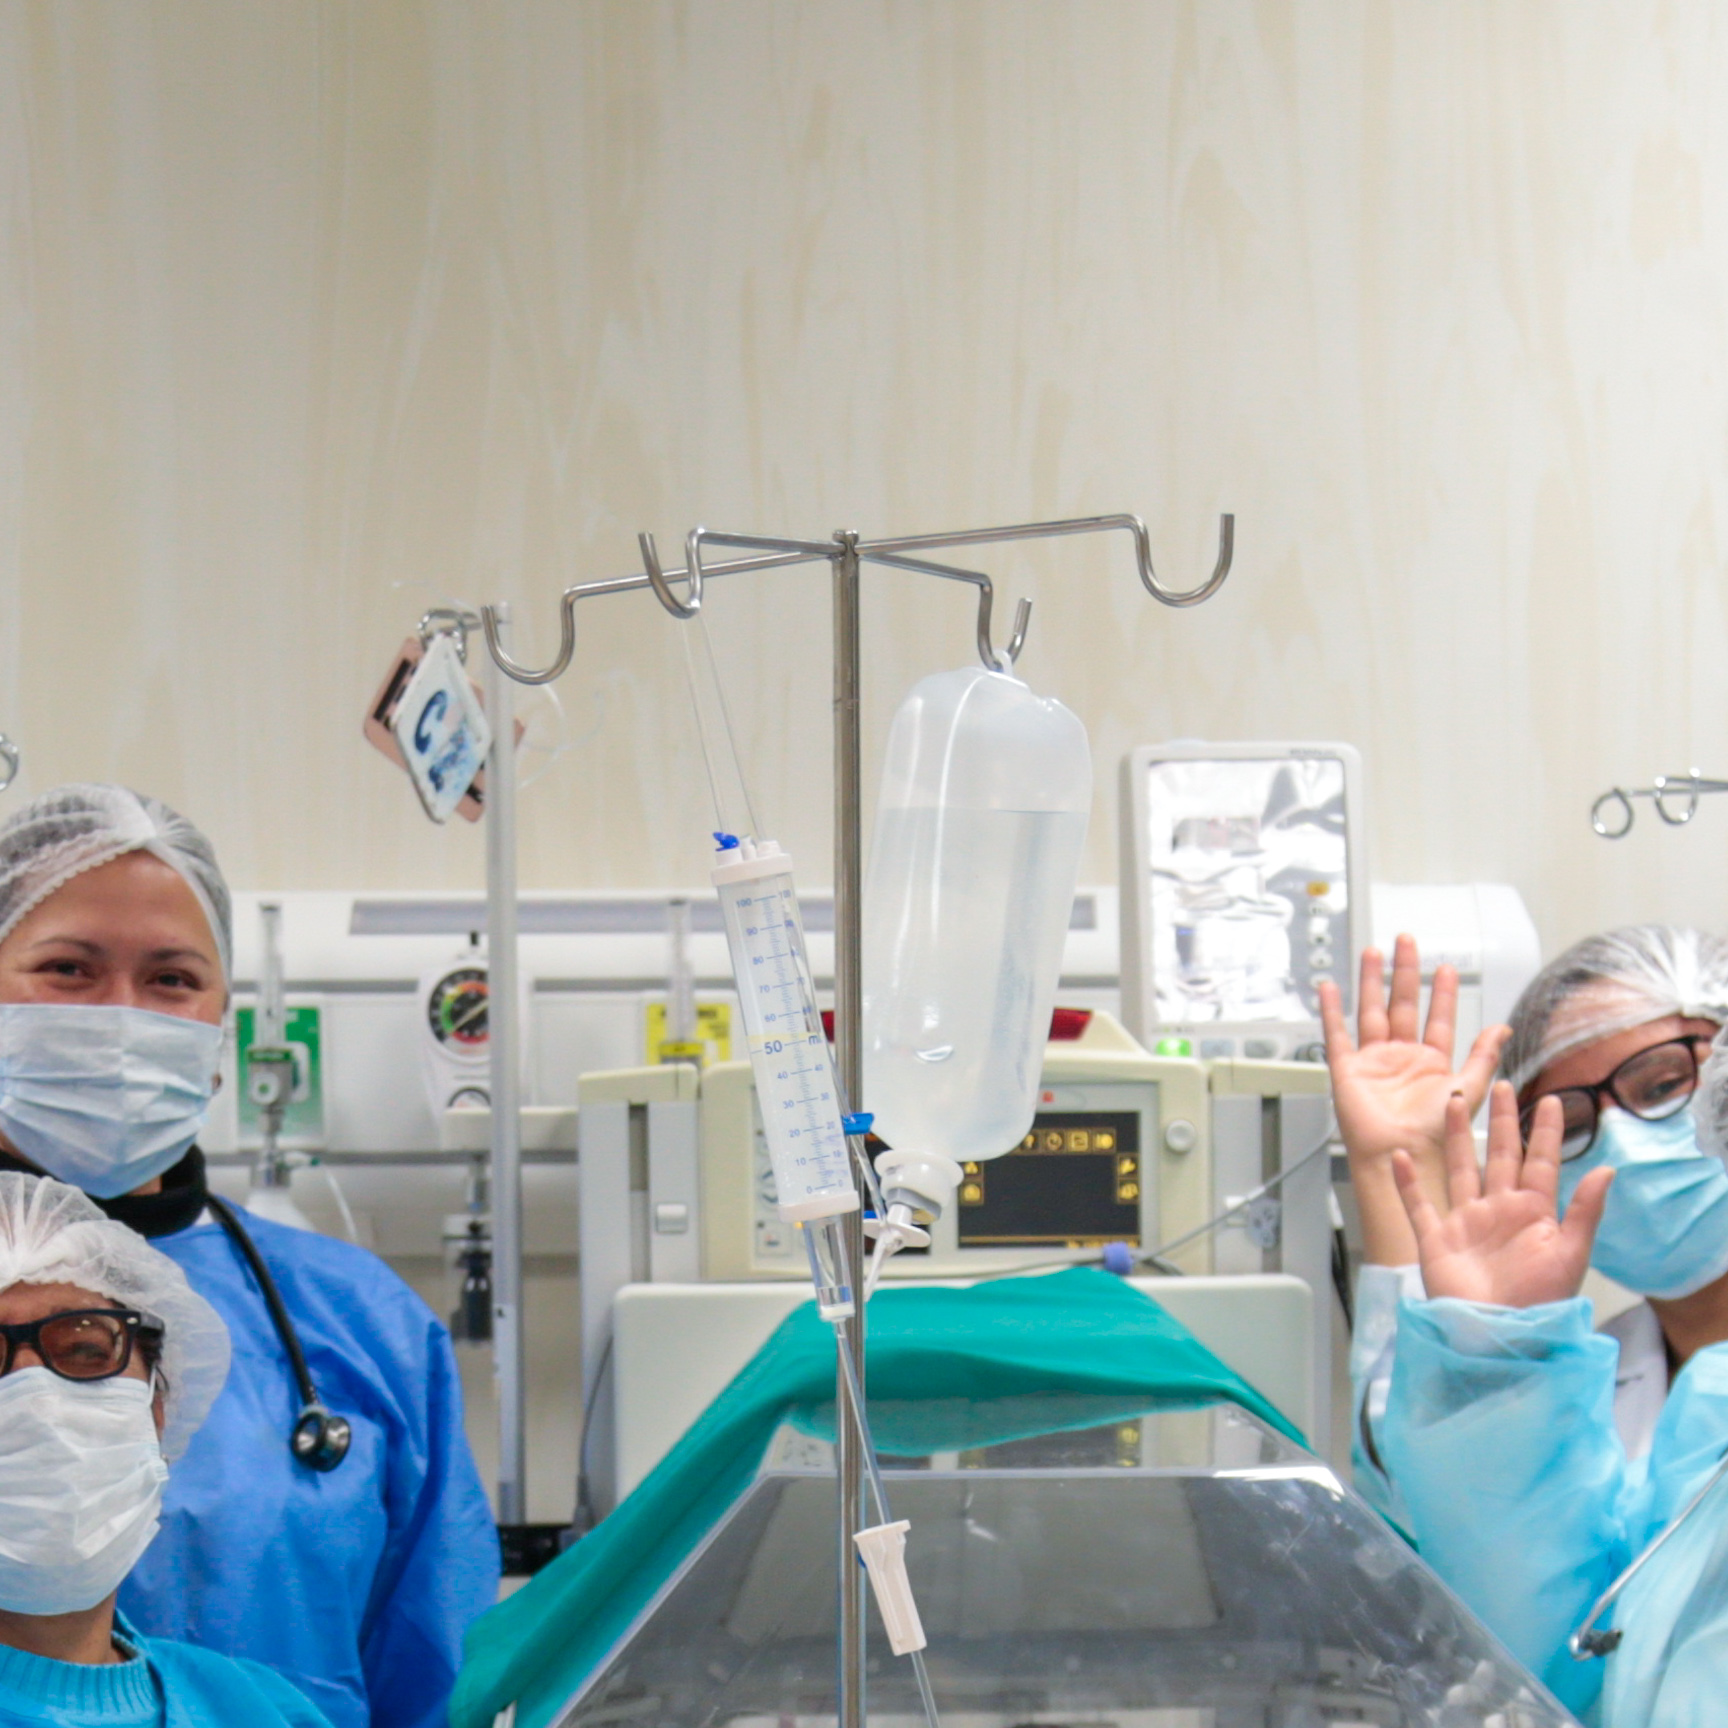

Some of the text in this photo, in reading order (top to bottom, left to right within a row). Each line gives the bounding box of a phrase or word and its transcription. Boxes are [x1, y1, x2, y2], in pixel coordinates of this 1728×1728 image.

[736, 898, 752, 908] 100
[746, 926, 758, 936] 90
[752, 956, 764, 965] 80
[759, 984, 771, 994] 70
[764, 1013, 776, 1022] 60
[764, 1040, 783, 1055] 50
[777, 1071, 788, 1080] 40
[783, 1100, 795, 1109] 30
[789, 1129, 800, 1138] 20
[796, 1157, 807, 1167] 10
[806, 1186, 813, 1194] 0
